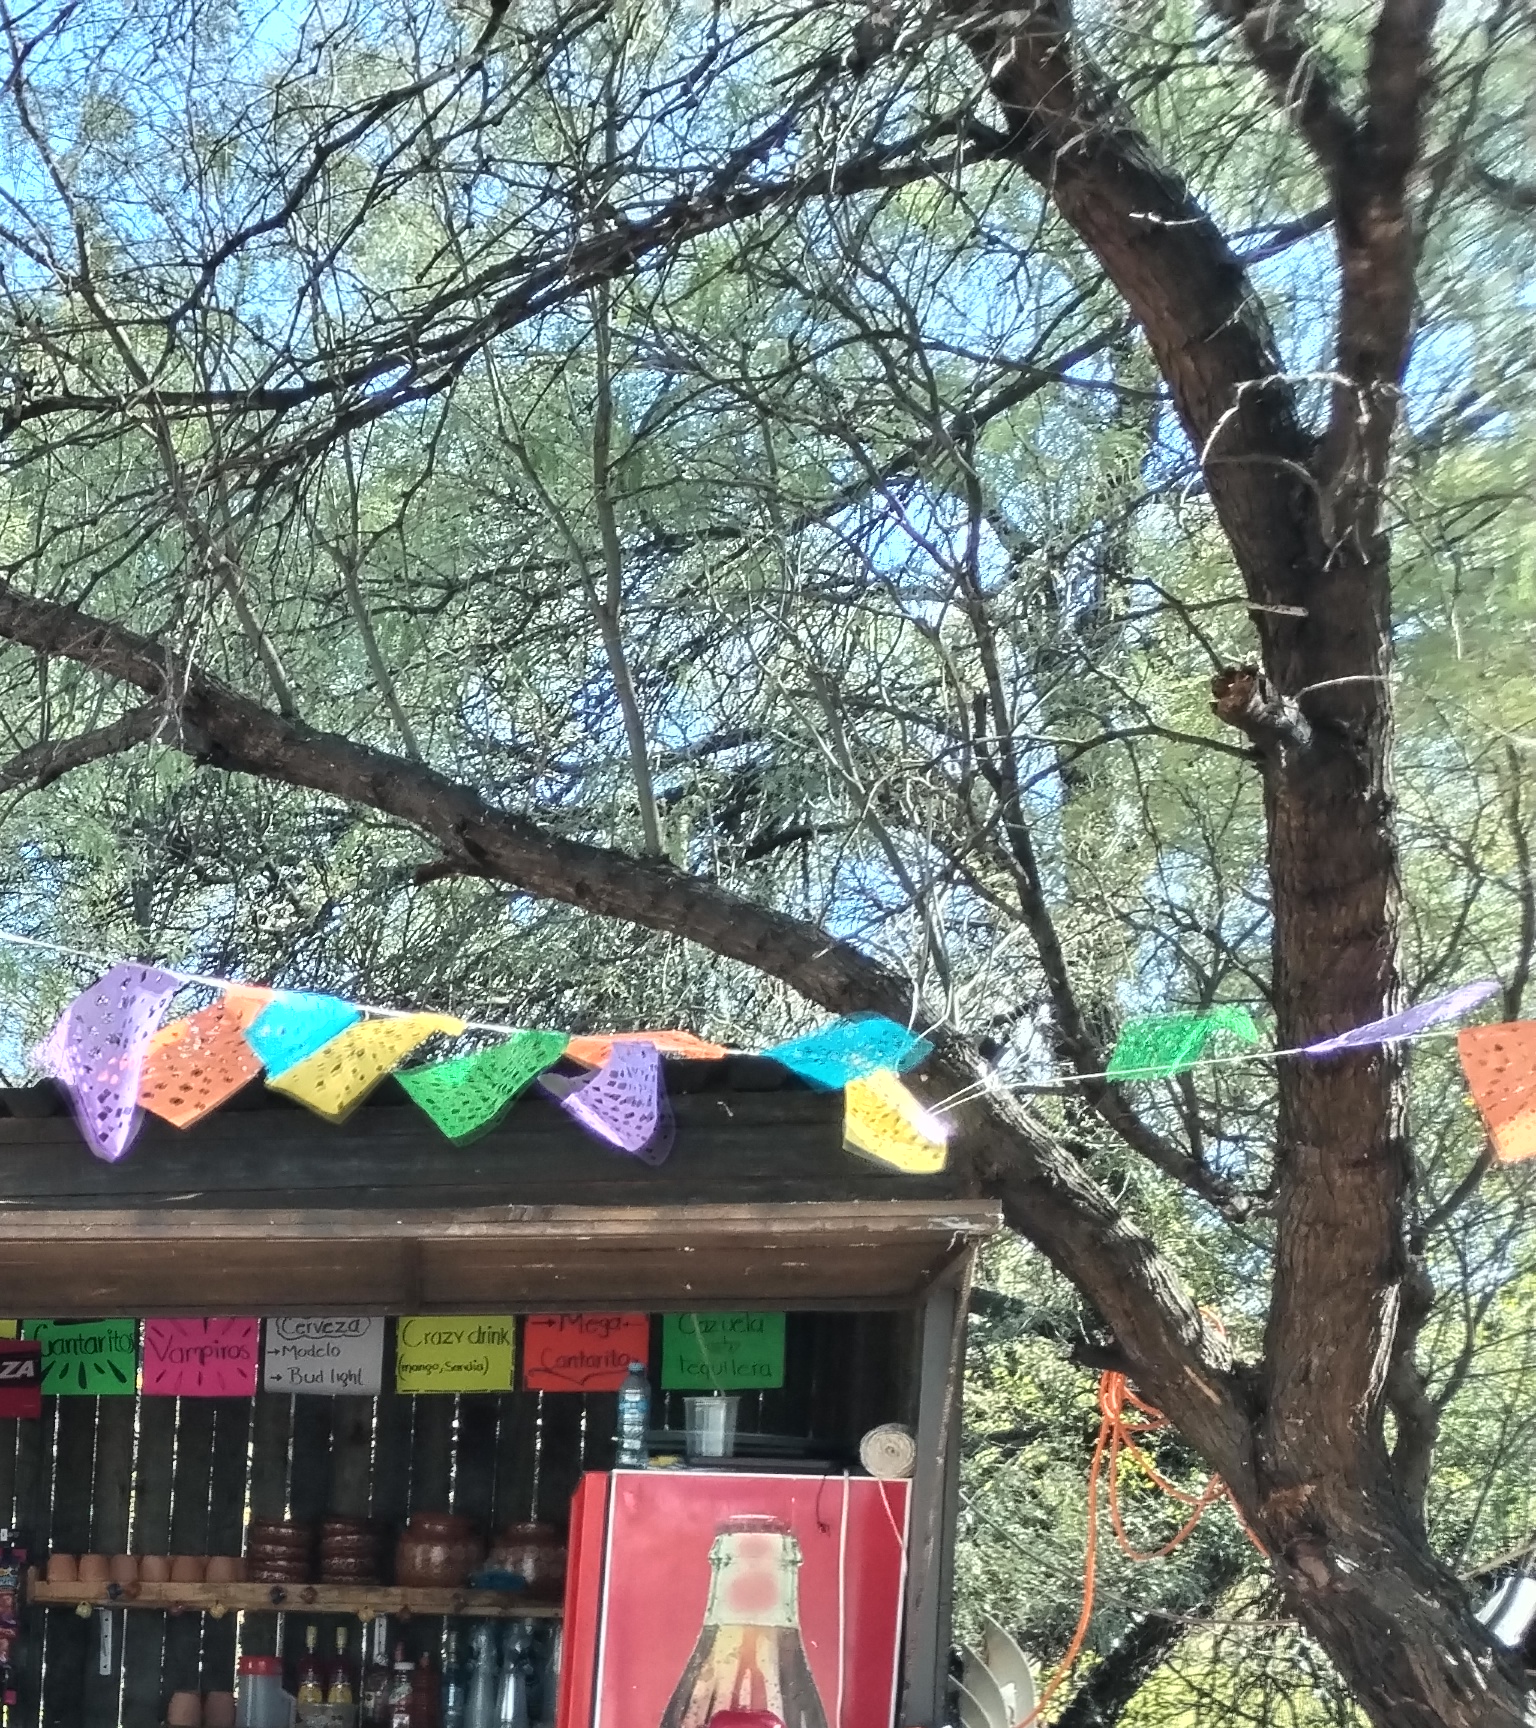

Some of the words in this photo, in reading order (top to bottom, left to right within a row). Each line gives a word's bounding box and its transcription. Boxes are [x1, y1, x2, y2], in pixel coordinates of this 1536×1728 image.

[282, 1318, 361, 1335] Cerveza
[402, 1319, 465, 1348] Crazy
[468, 1324, 511, 1346] drink
[559, 1314, 622, 1338] Mega
[147, 1335, 251, 1366] Vampiros
[282, 1342, 341, 1361] Modelo
[287, 1366, 324, 1385] Bud
[331, 1367, 364, 1387] light
